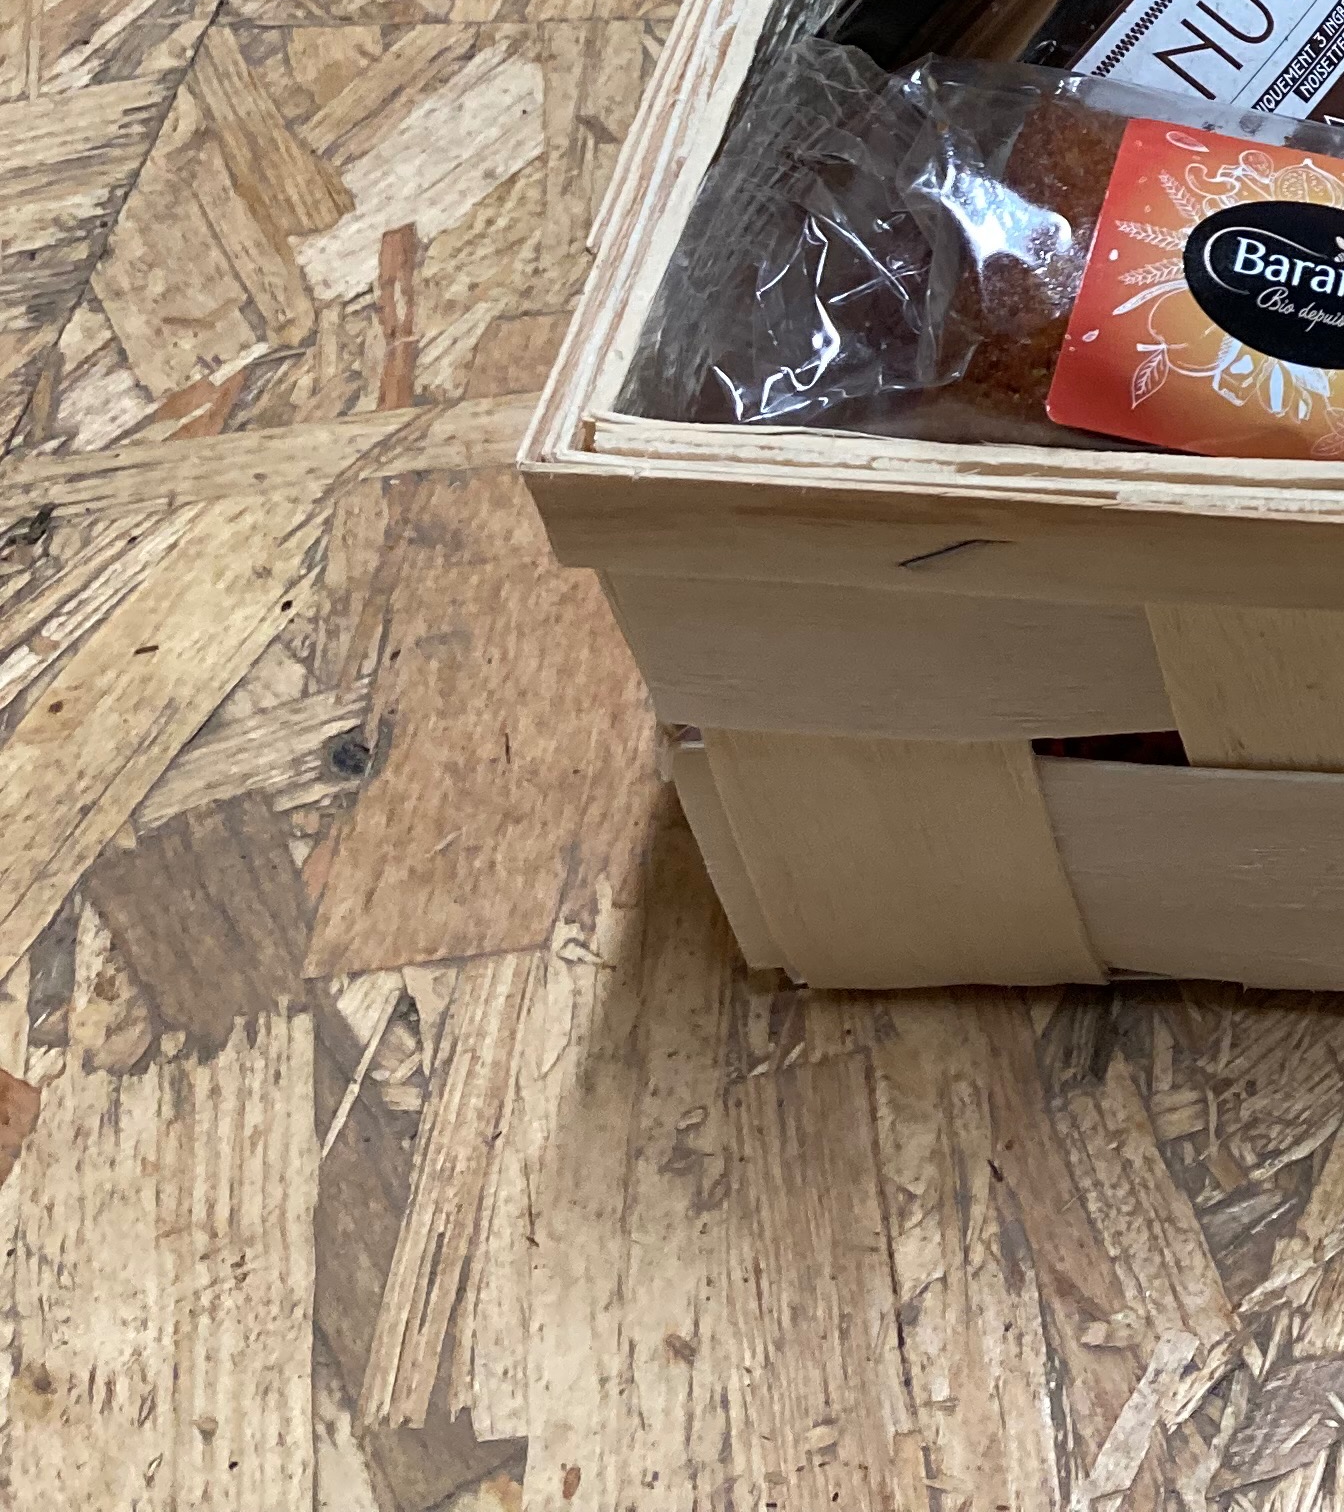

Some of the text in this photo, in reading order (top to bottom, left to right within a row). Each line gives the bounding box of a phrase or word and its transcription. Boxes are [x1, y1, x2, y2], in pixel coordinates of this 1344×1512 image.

[1256, 44, 1317, 113] IQUEMENT
[1313, 32, 1327, 48] 3
[1256, 286, 1295, 315] Bio
